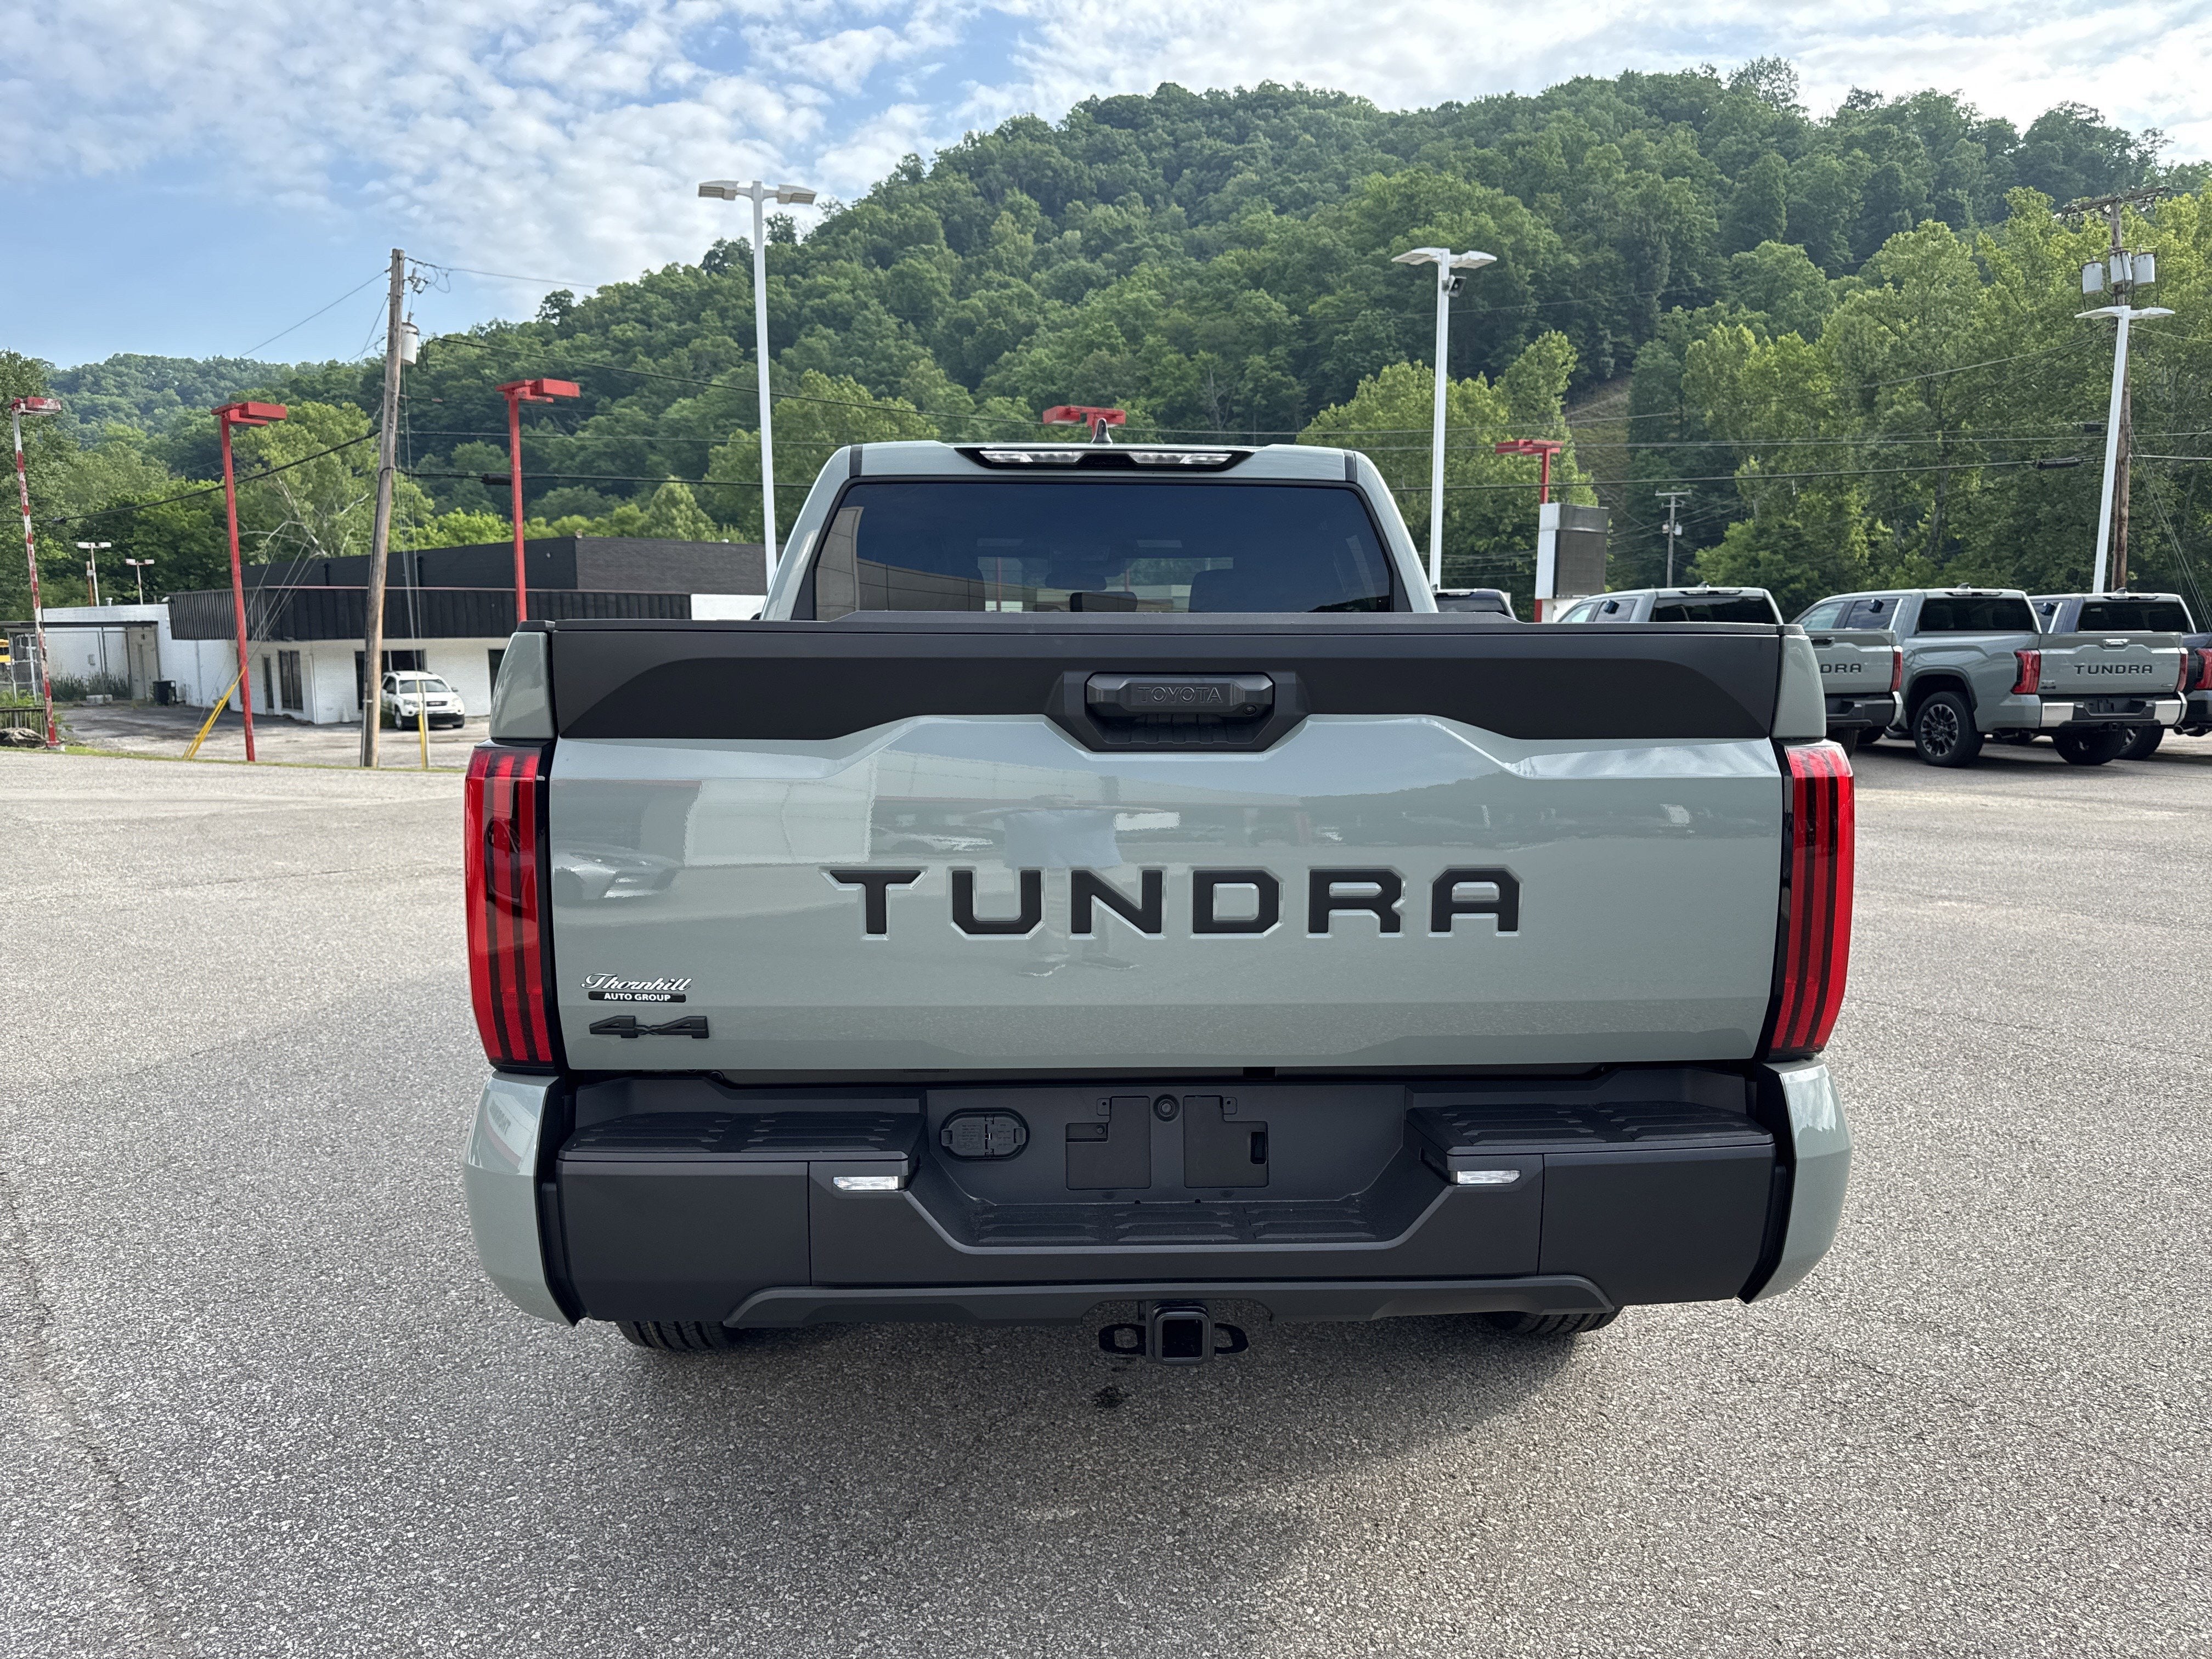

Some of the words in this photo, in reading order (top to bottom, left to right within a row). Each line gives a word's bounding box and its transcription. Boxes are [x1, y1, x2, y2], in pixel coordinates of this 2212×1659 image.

[1821, 663, 1861, 673] DRA
[2074, 664, 2153, 675] TUNDRA
[1137, 686, 1223, 703] TOYOTA
[827, 868, 1521, 937] TUNDRA
[580, 973, 692, 991] Thornhill
